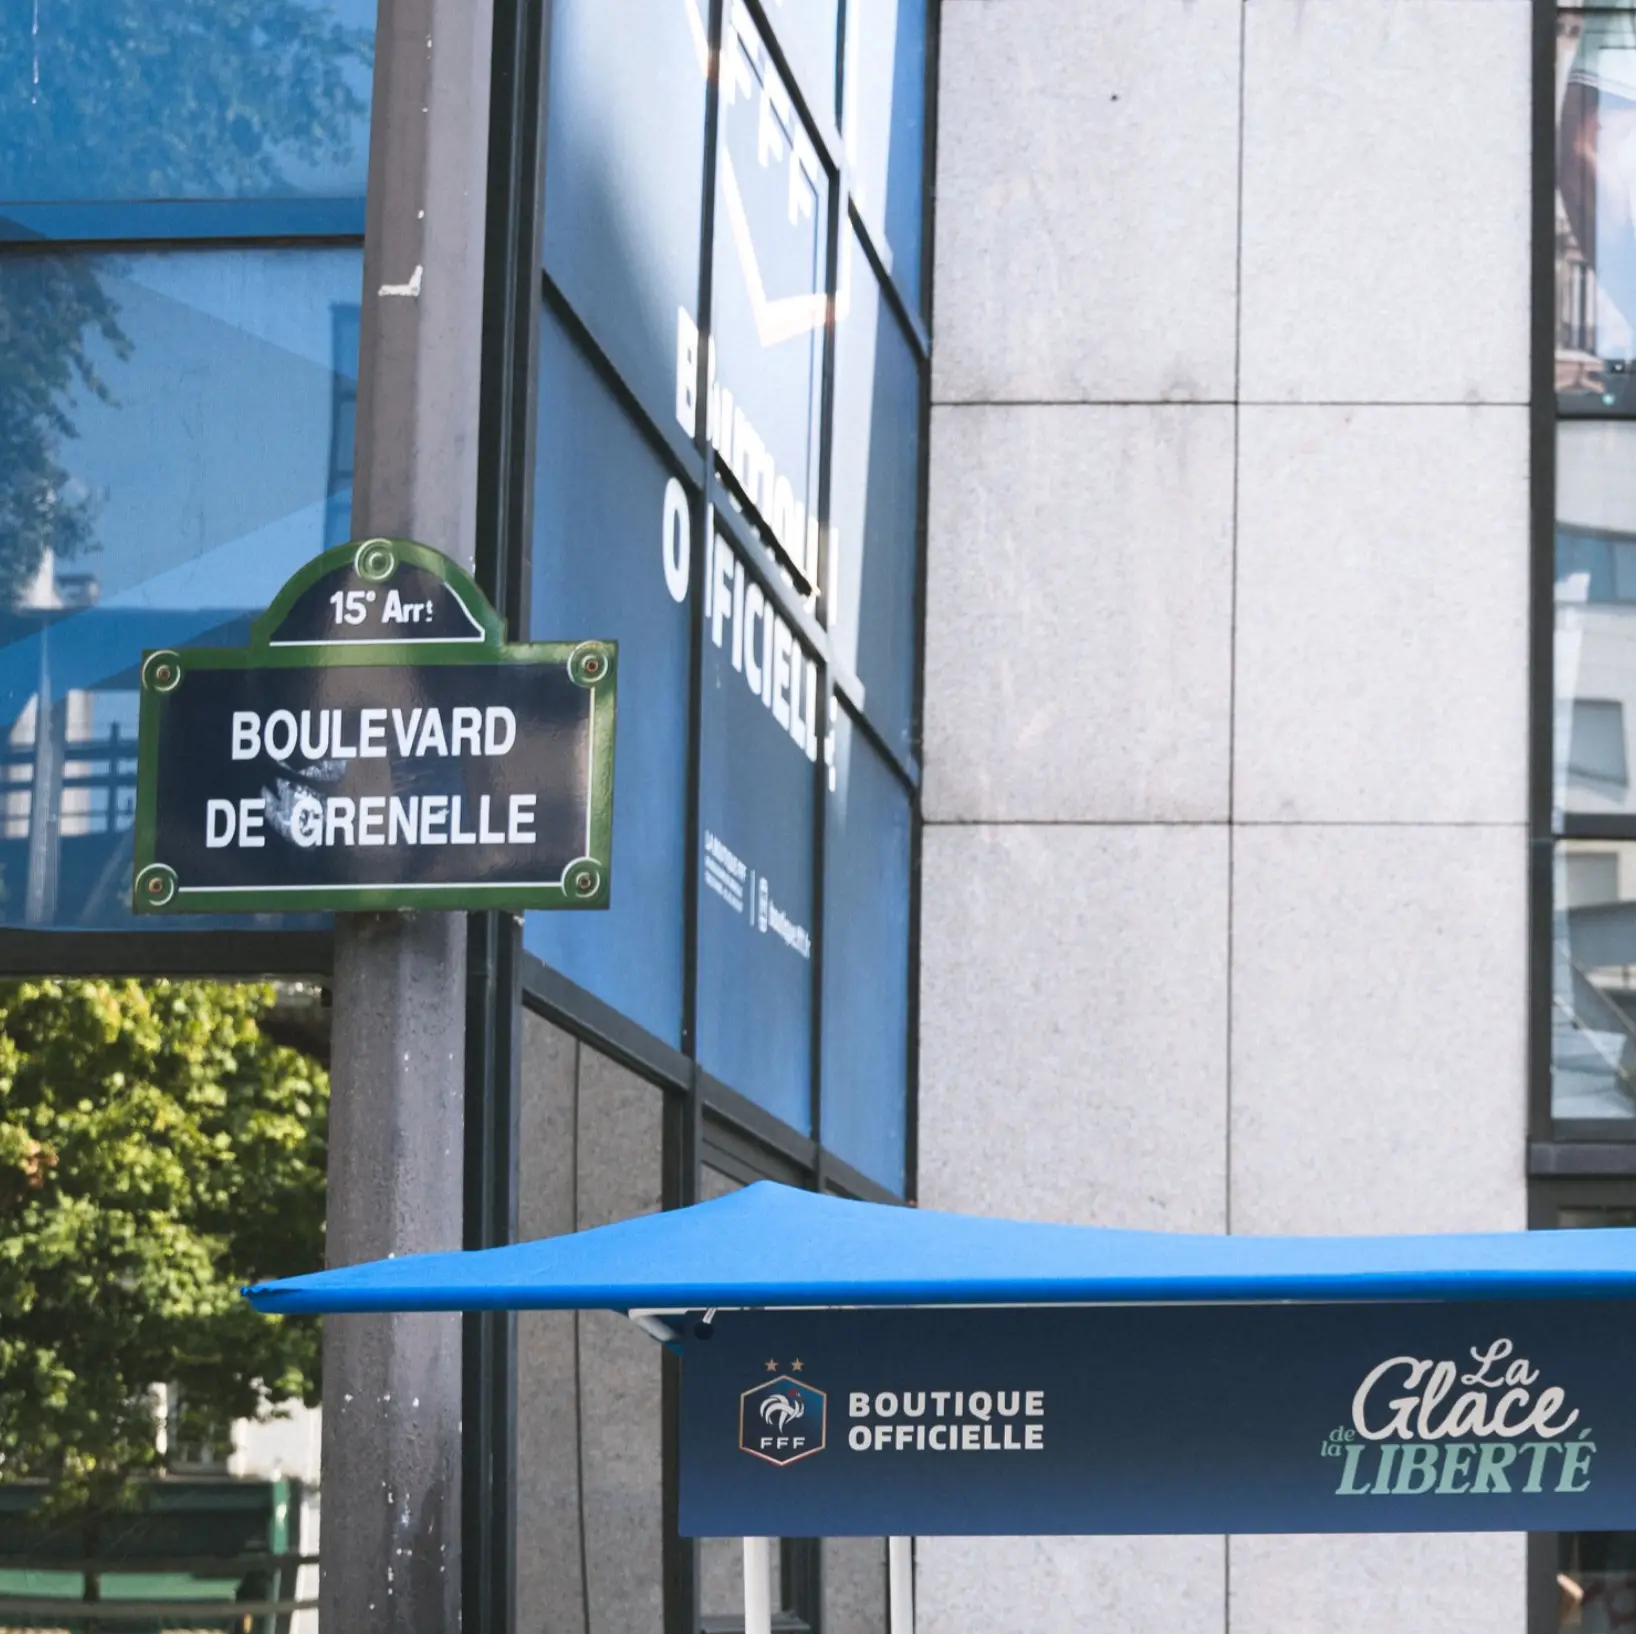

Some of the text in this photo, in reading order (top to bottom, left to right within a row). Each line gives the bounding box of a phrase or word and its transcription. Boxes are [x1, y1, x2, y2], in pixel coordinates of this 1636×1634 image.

[663, 476, 839, 793] OFICIELL
[231, 706, 517, 761] BOULEVARD
[206, 794, 537, 848] DE GRENELLE
[1461, 1338, 1540, 1388] La
[849, 1391, 1045, 1421] BOUTIQUE
[1352, 1356, 1579, 1440] Glace
[760, 1437, 805, 1449] FFF
[848, 1424, 1044, 1450] OFFICIELLE
[1320, 1441, 1342, 1457] la
[1329, 1425, 1355, 1442] de
[1335, 1428, 1597, 1495] LIBERTÉ
